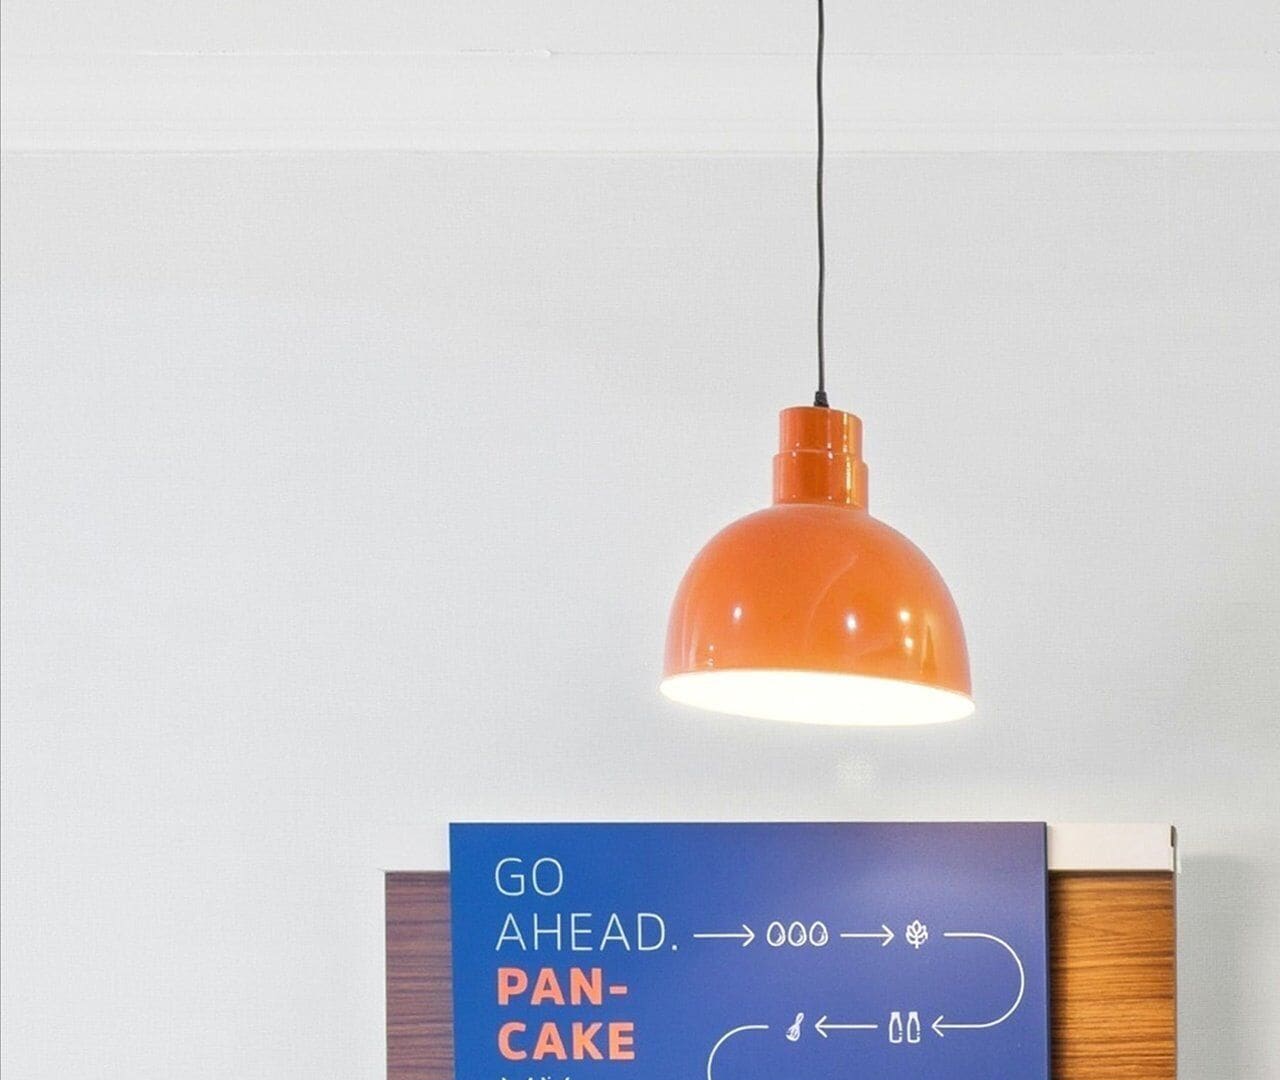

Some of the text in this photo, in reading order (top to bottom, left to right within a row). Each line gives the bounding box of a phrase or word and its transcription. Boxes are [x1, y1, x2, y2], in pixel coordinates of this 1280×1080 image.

[495, 858, 564, 897] GO
[495, 913, 679, 952] AHEAD.
[498, 968, 628, 1005] PAN-
[498, 1022, 636, 1061] CAKE
